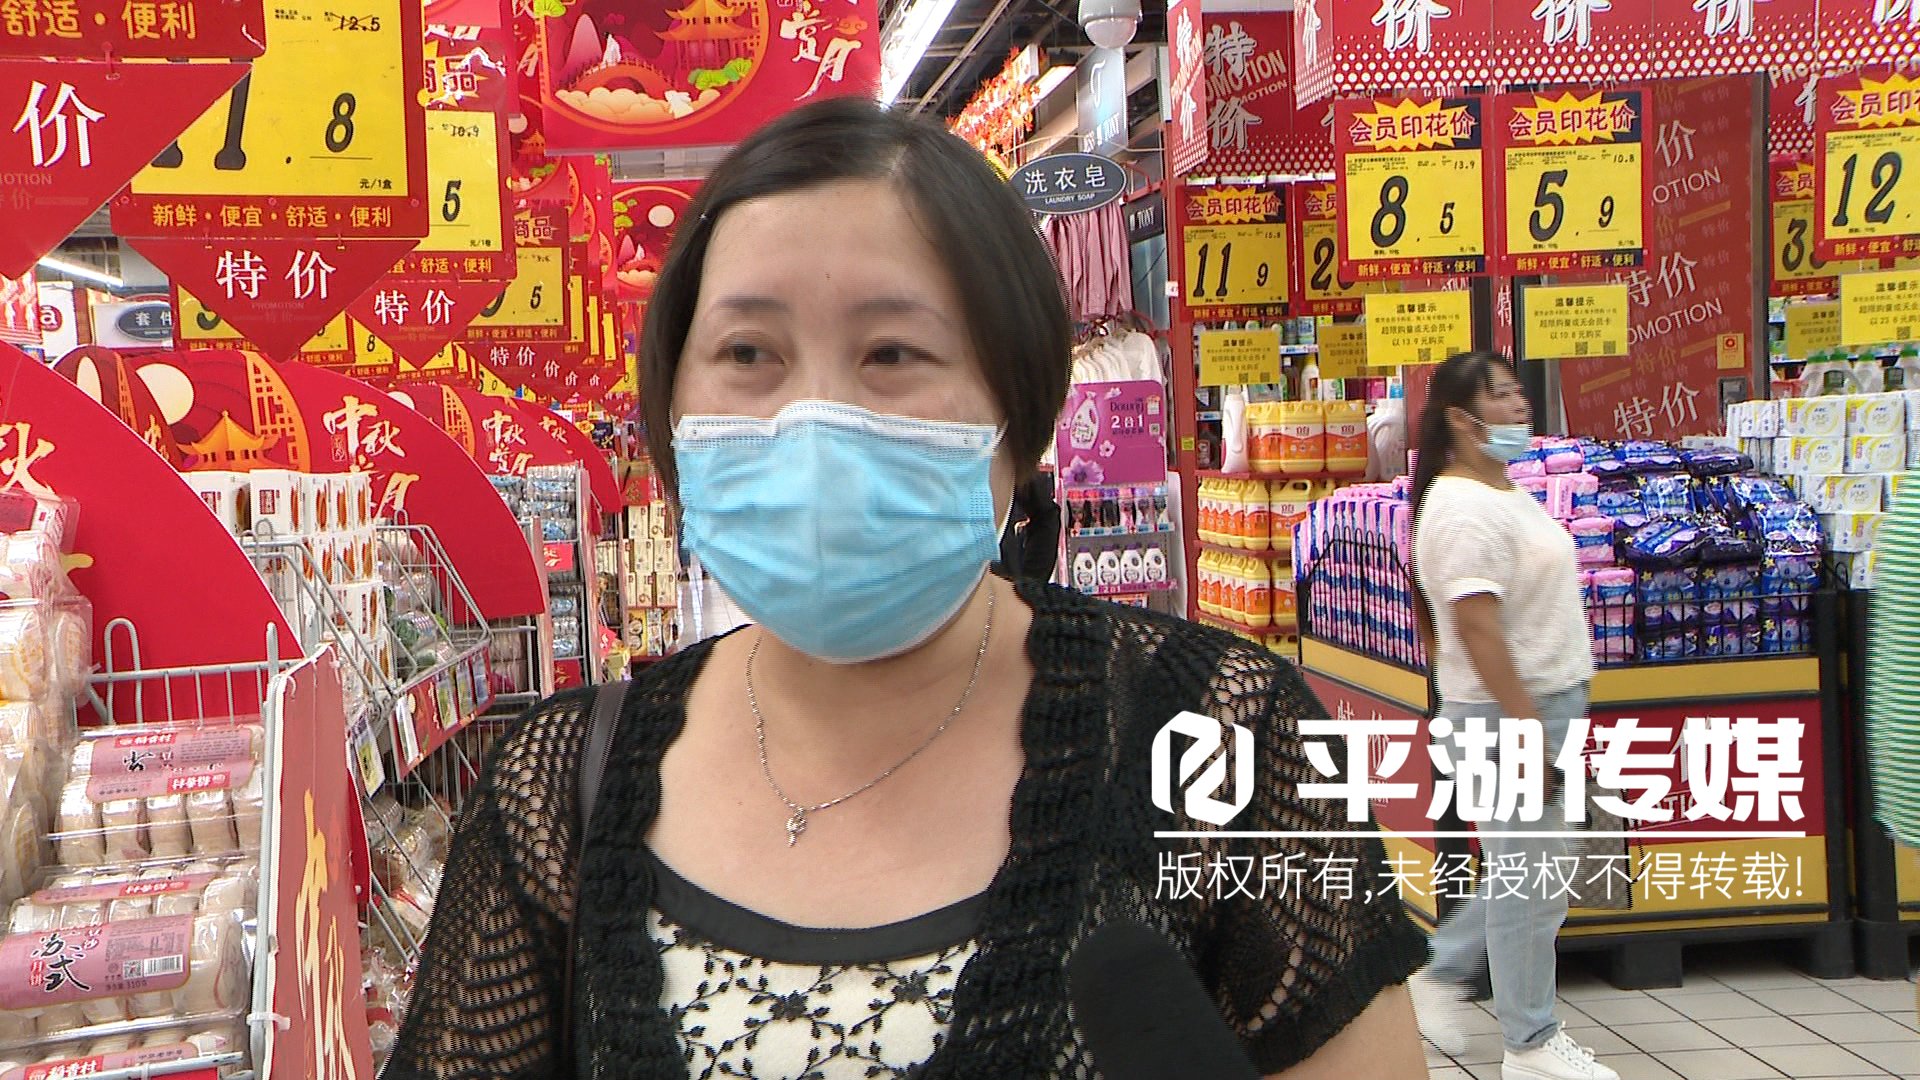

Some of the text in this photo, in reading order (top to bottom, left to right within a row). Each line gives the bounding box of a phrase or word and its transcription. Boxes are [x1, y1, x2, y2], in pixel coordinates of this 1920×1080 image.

[339, 15, 380, 32] 12.5
[13, 80, 105, 167] 价
[1207, 96, 1264, 151] 价
[1350, 108, 1477, 144] 会员印花价
[1509, 104, 1635, 138] 会员印花价
[1613, 153, 1635, 164] 10.8
[1654, 119, 1696, 168] 价
[1024, 163, 1106, 196] 洗衣皂
[1454, 160, 1475, 170] 13.9
[443, 180, 462, 222] 5
[1045, 192, 1096, 205] LAUNDRY SOAP
[1186, 192, 1282, 219] 会员印花价
[152, 203, 392, 229] 新鲜·便宜·舒适·便利
[215, 248, 337, 301] 特价
[374, 289, 456, 325] 特价
[490, 346, 536, 366] 特价
[544, 360, 561, 378] 价
[322, 395, 406, 457] 中秋
[482, 410, 528, 445] 中秋
[1613, 382, 1699, 439] 特价
